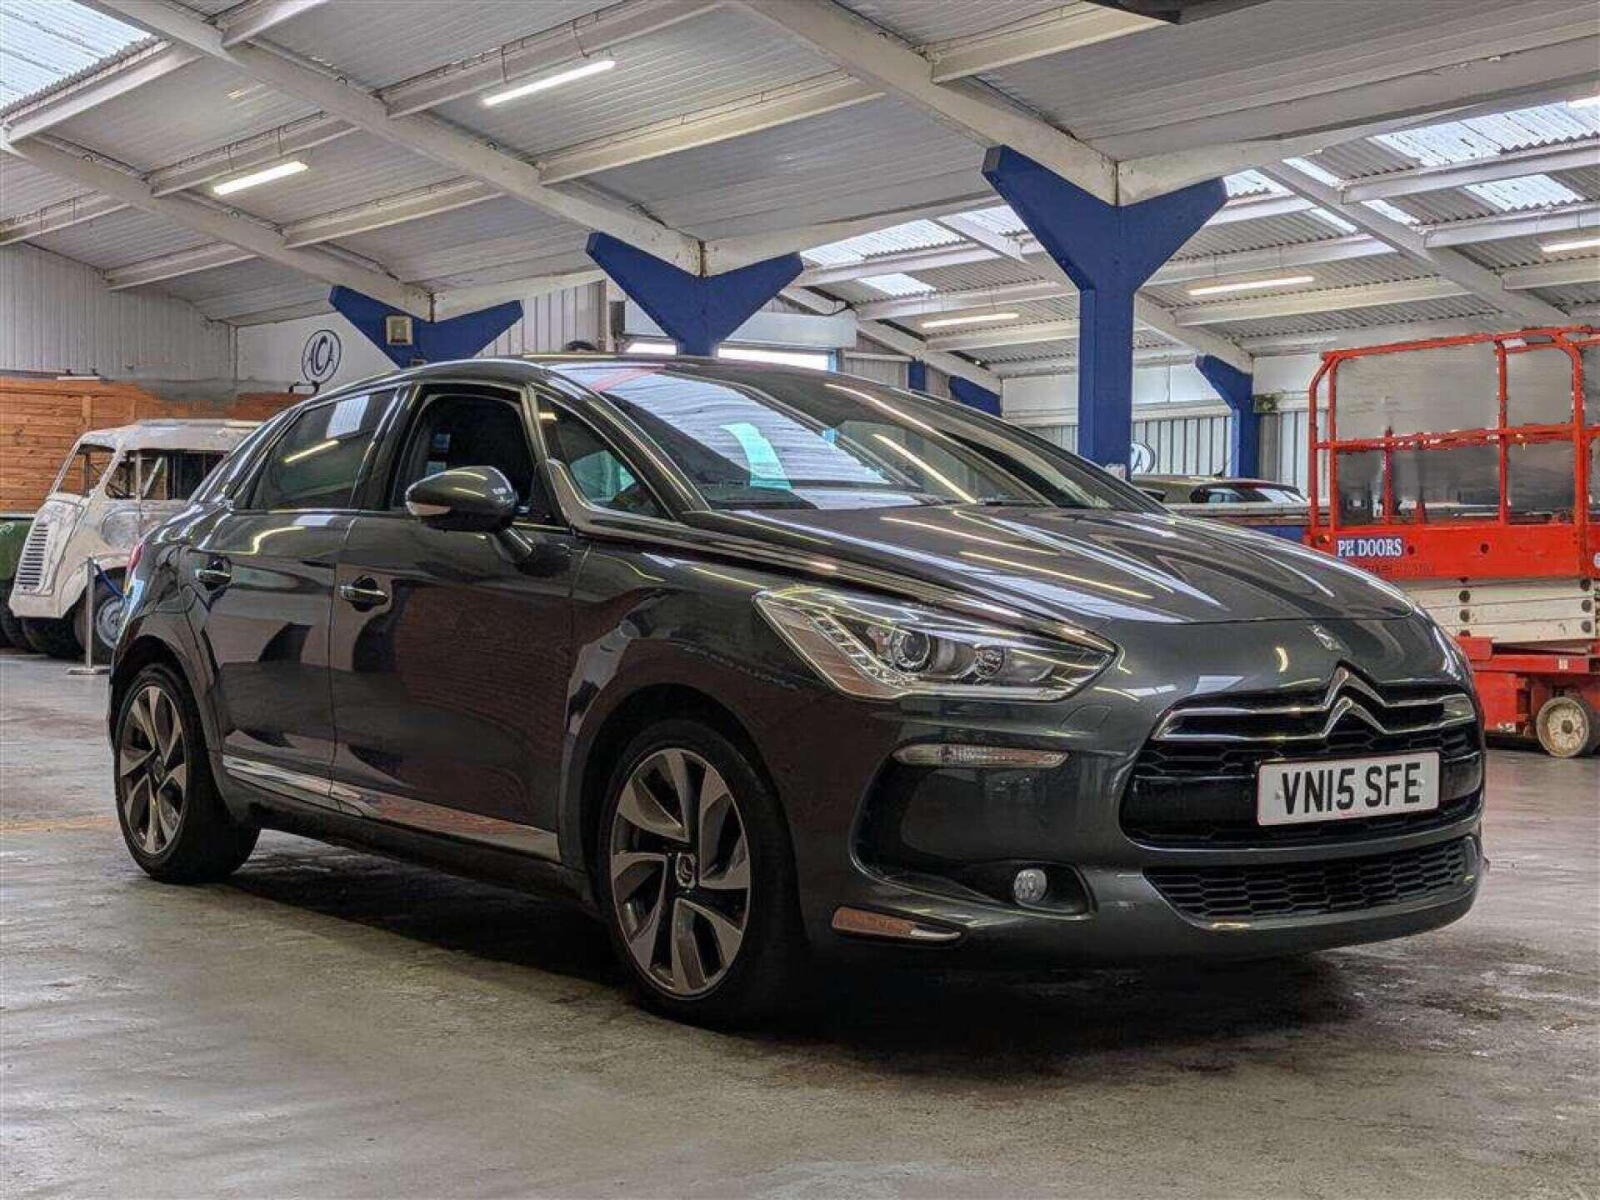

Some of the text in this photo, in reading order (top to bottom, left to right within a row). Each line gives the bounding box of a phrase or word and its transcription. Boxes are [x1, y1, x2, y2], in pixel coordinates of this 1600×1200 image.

[1358, 538, 1402, 557] DOORS
[1282, 762, 1421, 815] VN15 SFE
